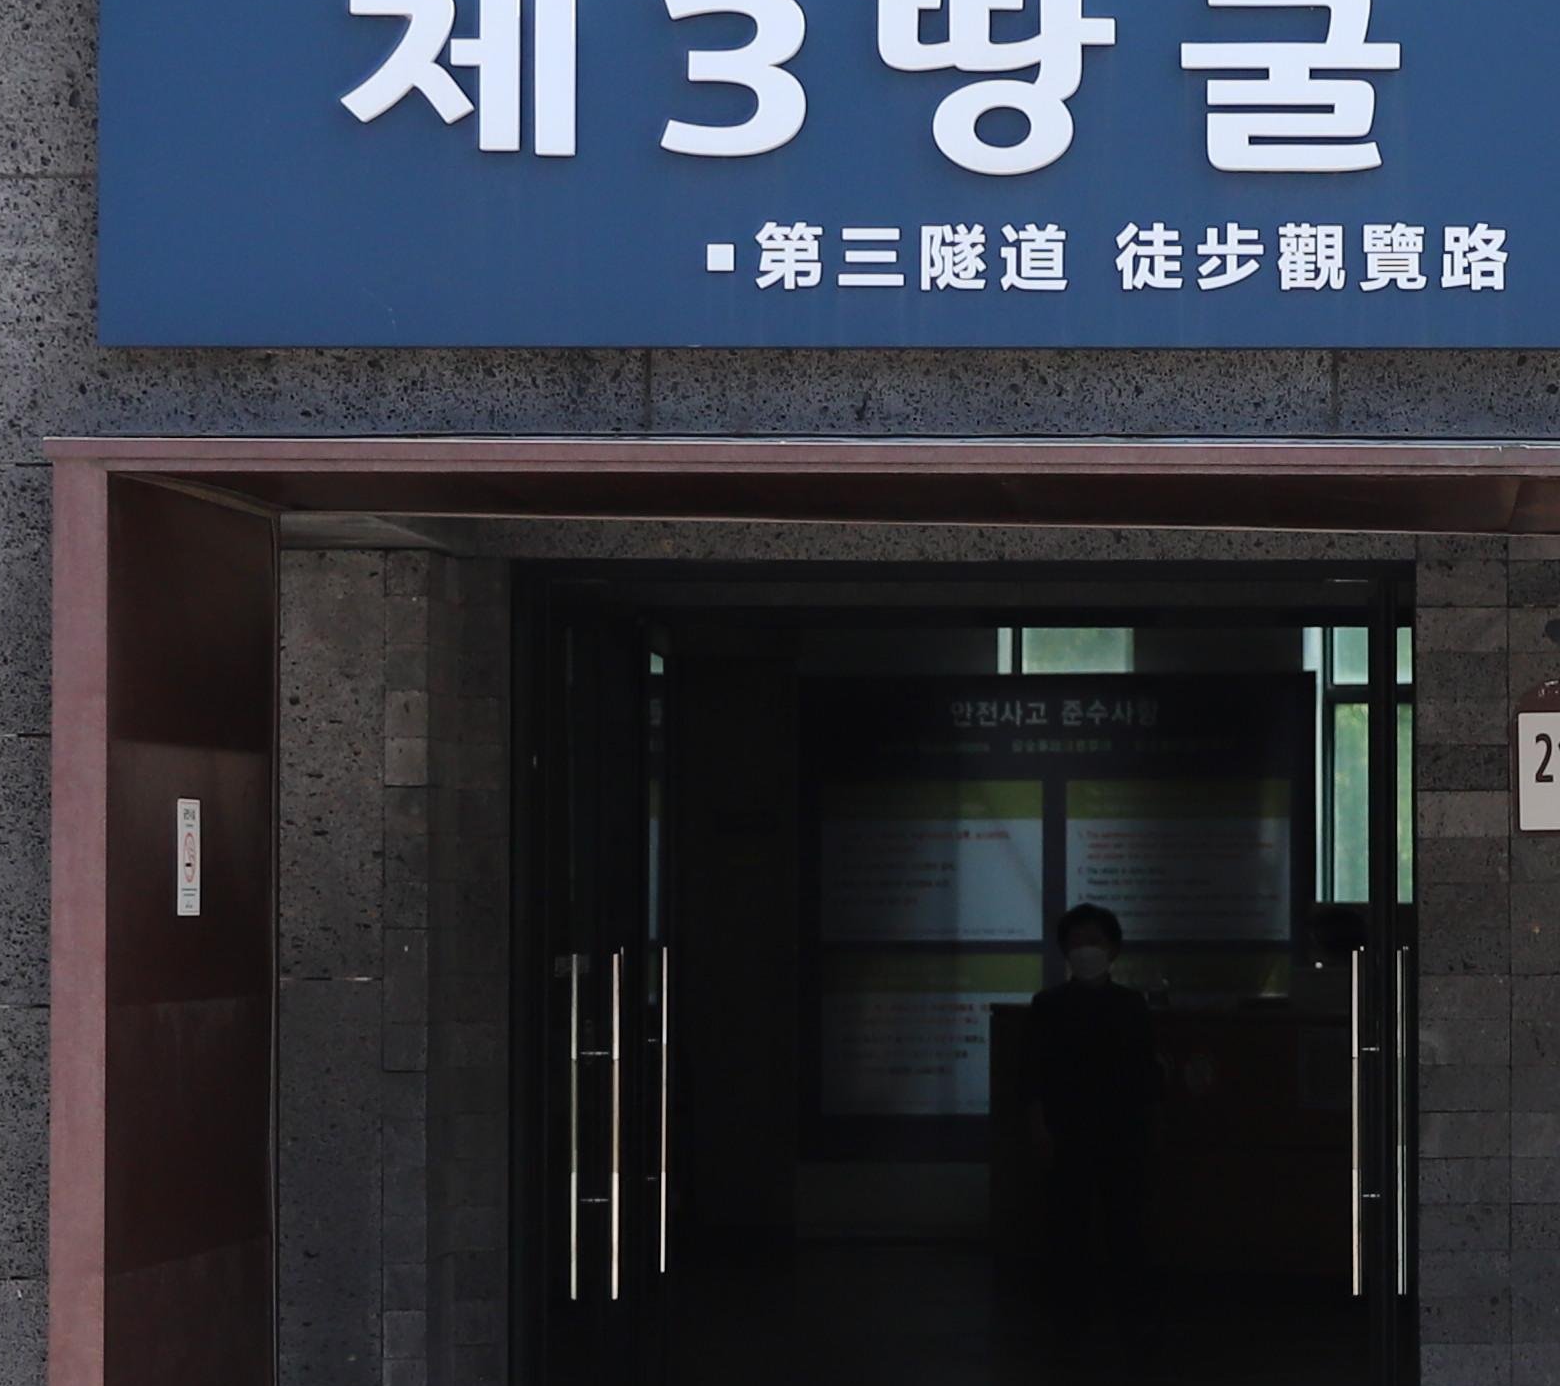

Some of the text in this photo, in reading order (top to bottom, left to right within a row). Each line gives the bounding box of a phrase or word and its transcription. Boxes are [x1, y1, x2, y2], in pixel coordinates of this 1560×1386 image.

[756, 222, 1507, 290] 第三隧道 徒步觀覽路
